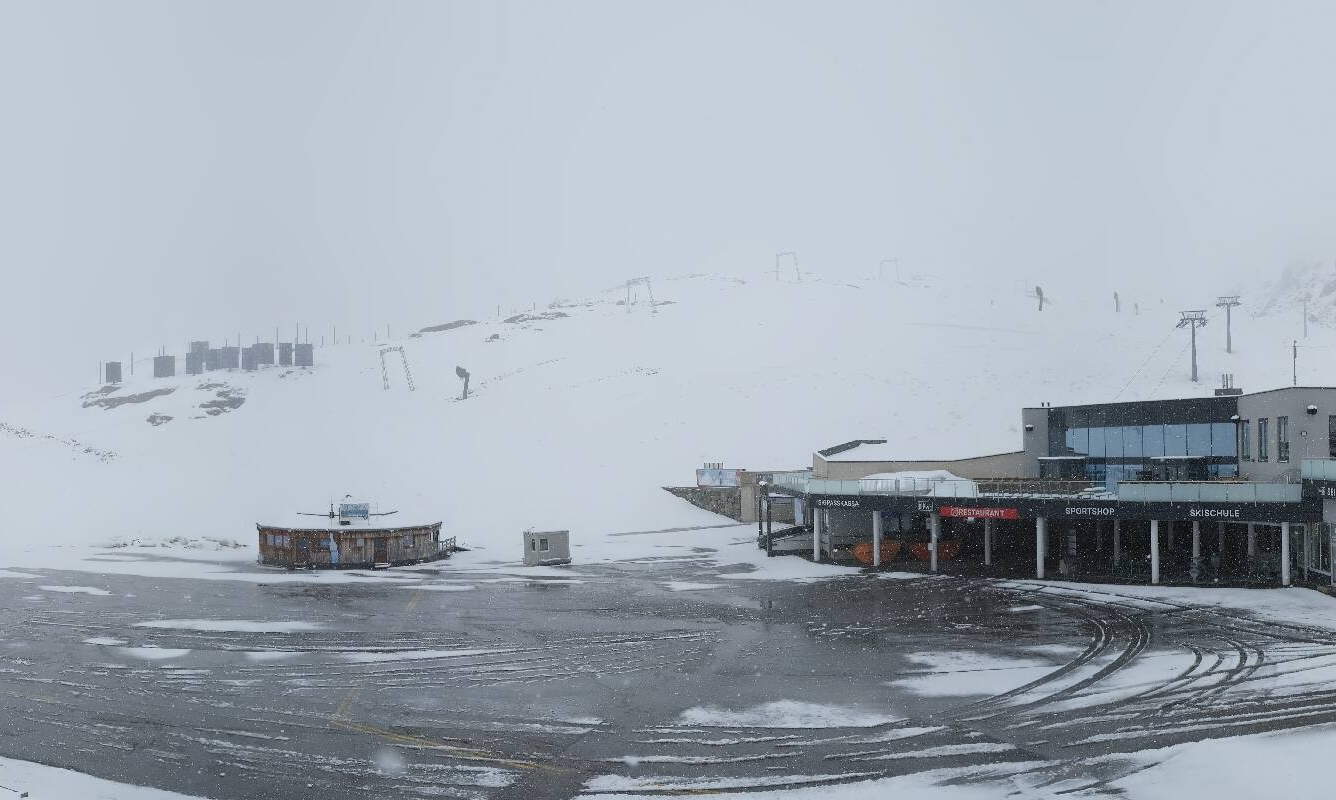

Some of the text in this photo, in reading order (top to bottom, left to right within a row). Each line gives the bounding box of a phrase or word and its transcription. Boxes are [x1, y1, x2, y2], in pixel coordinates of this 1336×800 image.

[958, 508, 1005, 517] RESTAURANT
[1065, 507, 1115, 516] SPORTSHOP
[1189, 509, 1240, 518] SKISCHULE
